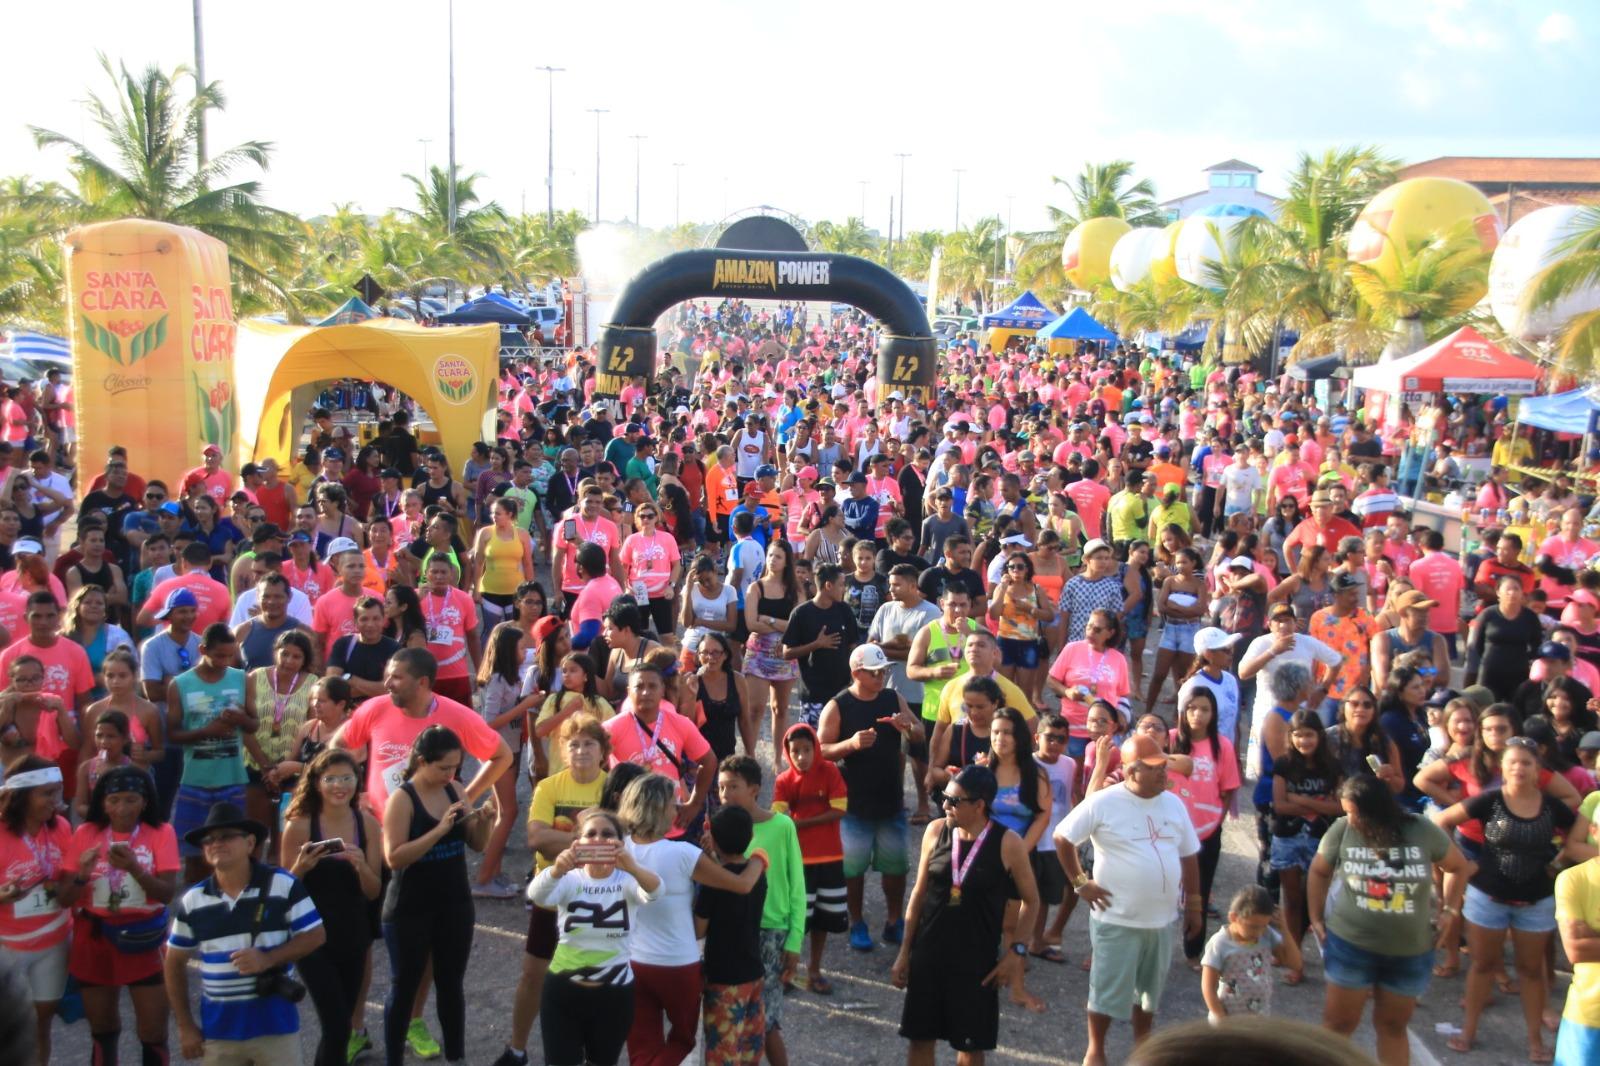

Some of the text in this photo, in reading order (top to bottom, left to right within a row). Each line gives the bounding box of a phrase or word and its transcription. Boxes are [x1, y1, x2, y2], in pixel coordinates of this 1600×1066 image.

[86, 271, 157, 289] SANTA
[712, 259, 830, 291] AMAZON POWER
[80, 290, 169, 311] CLARA
[437, 367, 471, 377] CLARA
[439, 360, 466, 369] SANTA
[1346, 846, 1421, 860] THEE IS
[1343, 861, 1378, 876] ONL
[1348, 877, 1419, 894] MIEY
[564, 899, 630, 933] 24
